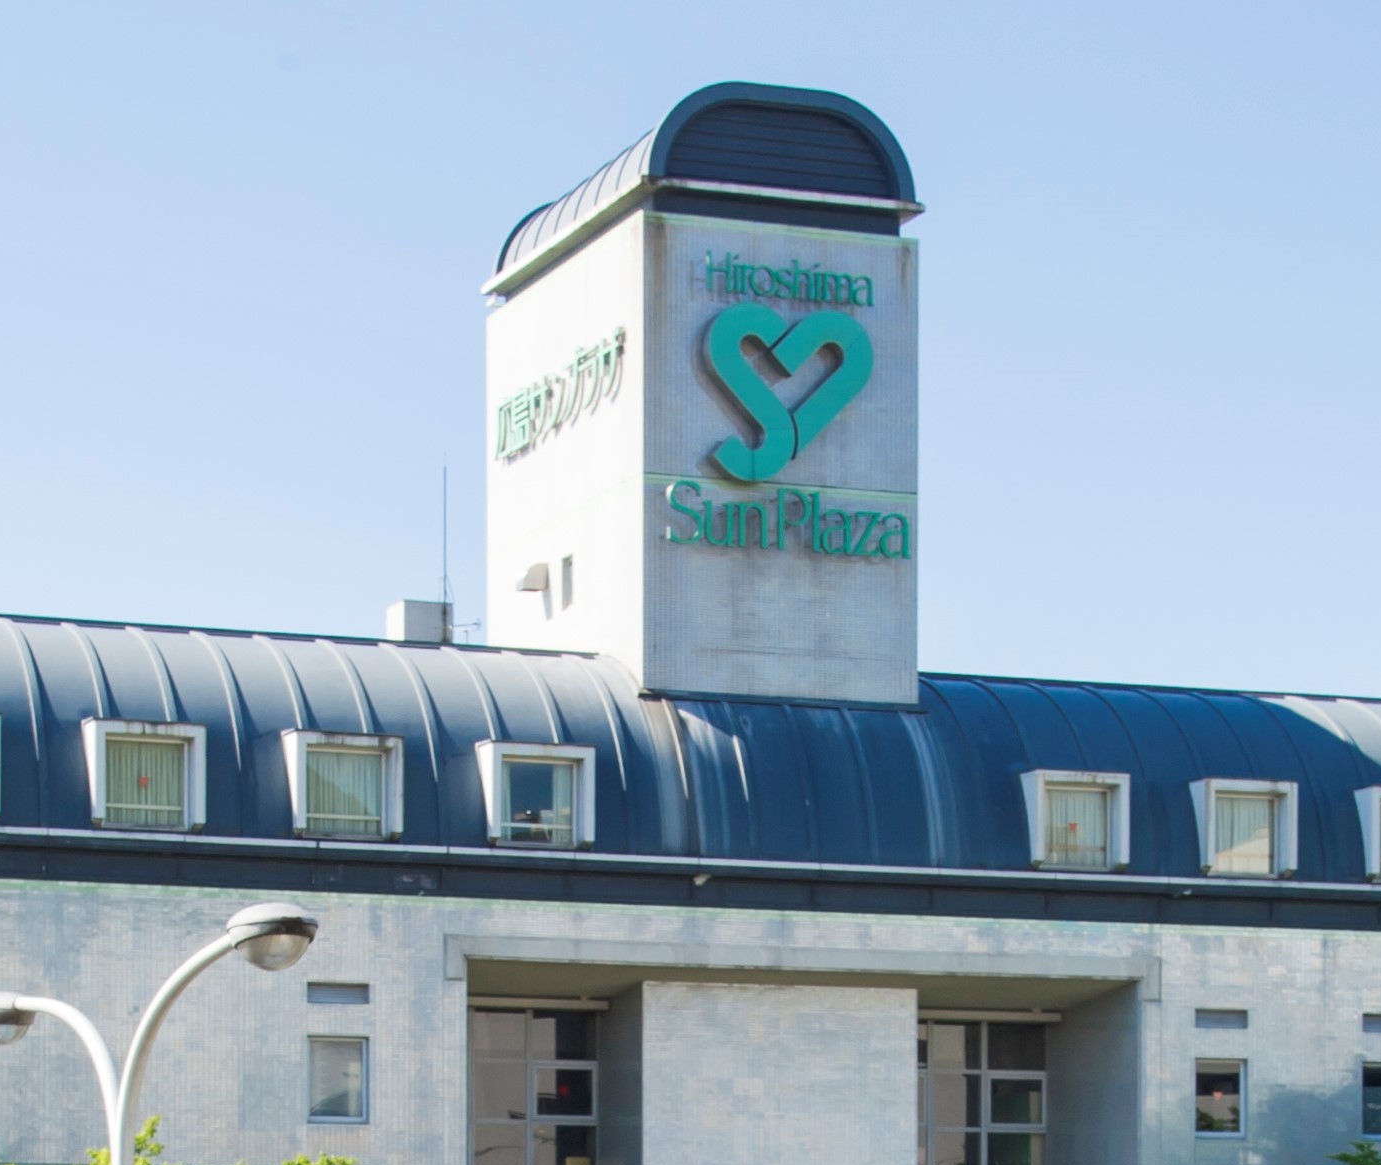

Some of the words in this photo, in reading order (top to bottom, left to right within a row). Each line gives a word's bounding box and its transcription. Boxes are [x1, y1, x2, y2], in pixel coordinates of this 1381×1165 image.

[705, 250, 874, 307] Hiroshima
[495, 326, 626, 462] 広島サンプラザ
